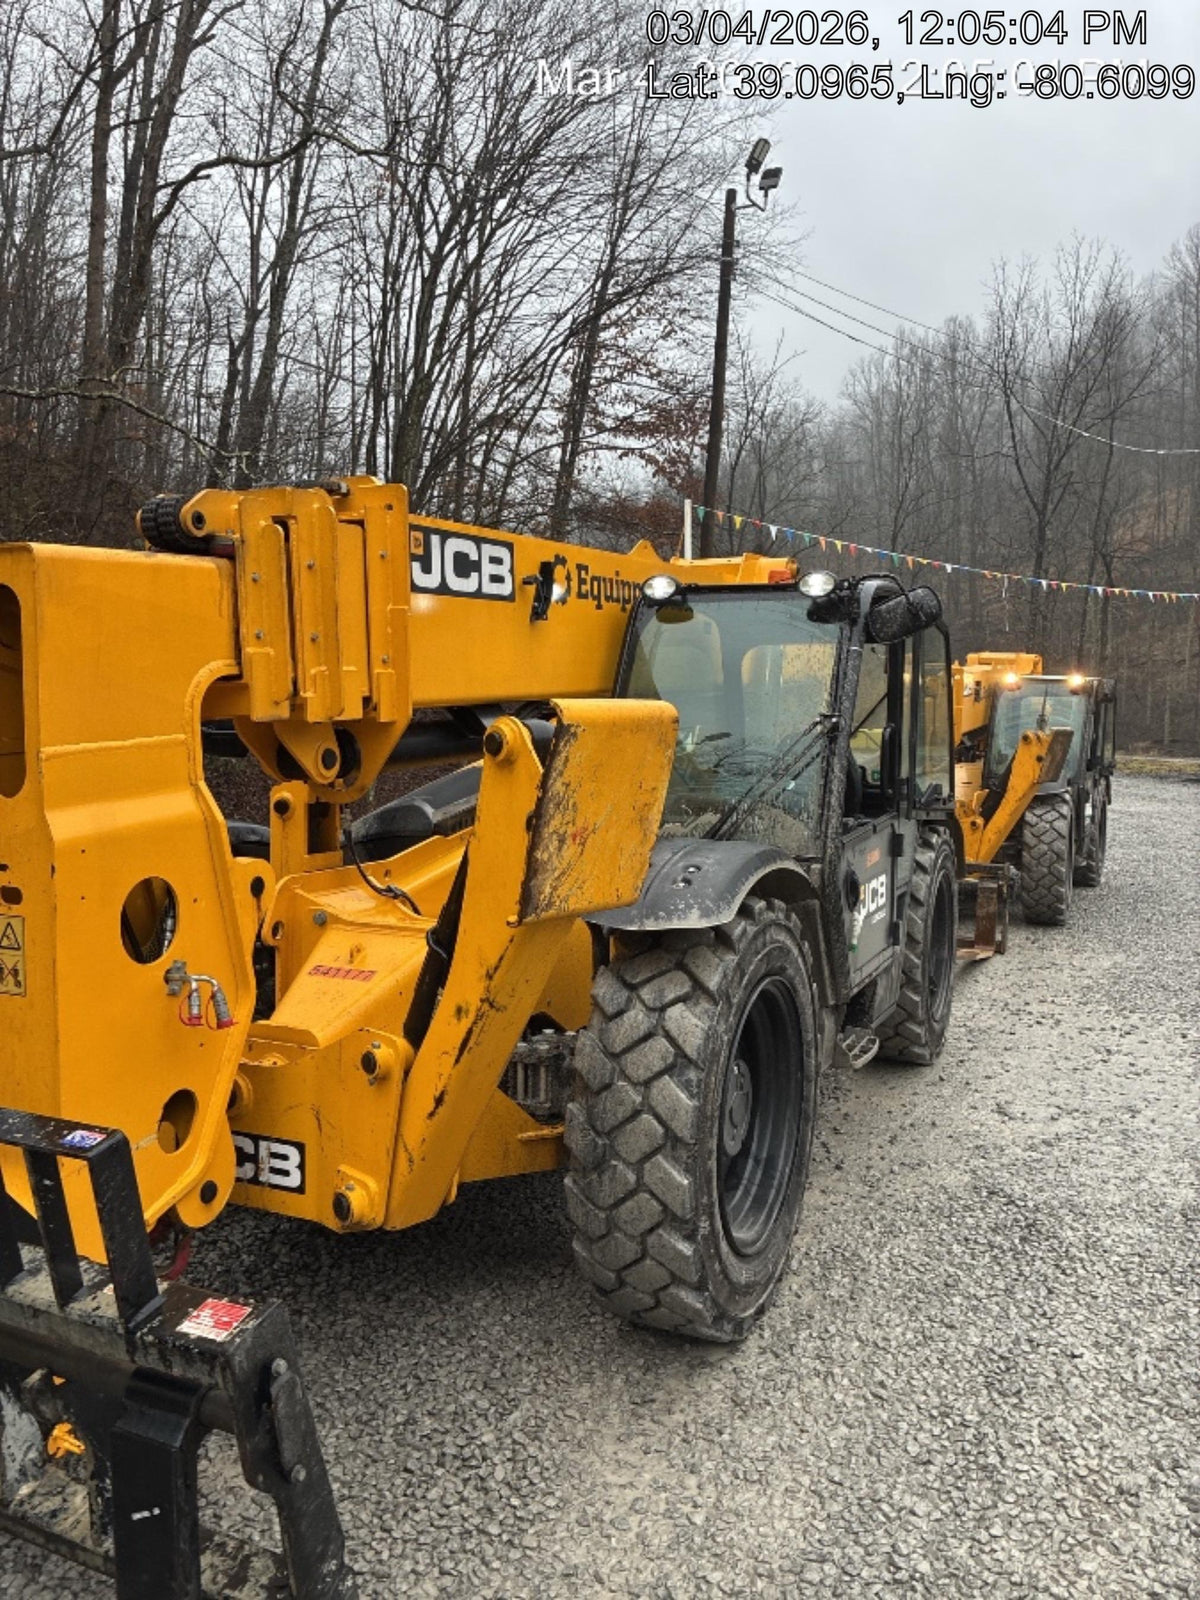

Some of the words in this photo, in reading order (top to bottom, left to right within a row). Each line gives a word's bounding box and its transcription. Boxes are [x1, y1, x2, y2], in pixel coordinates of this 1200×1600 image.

[411, 534, 513, 597] JCB
[860, 874, 886, 918] JCB
[232, 1135, 302, 1188] CB
